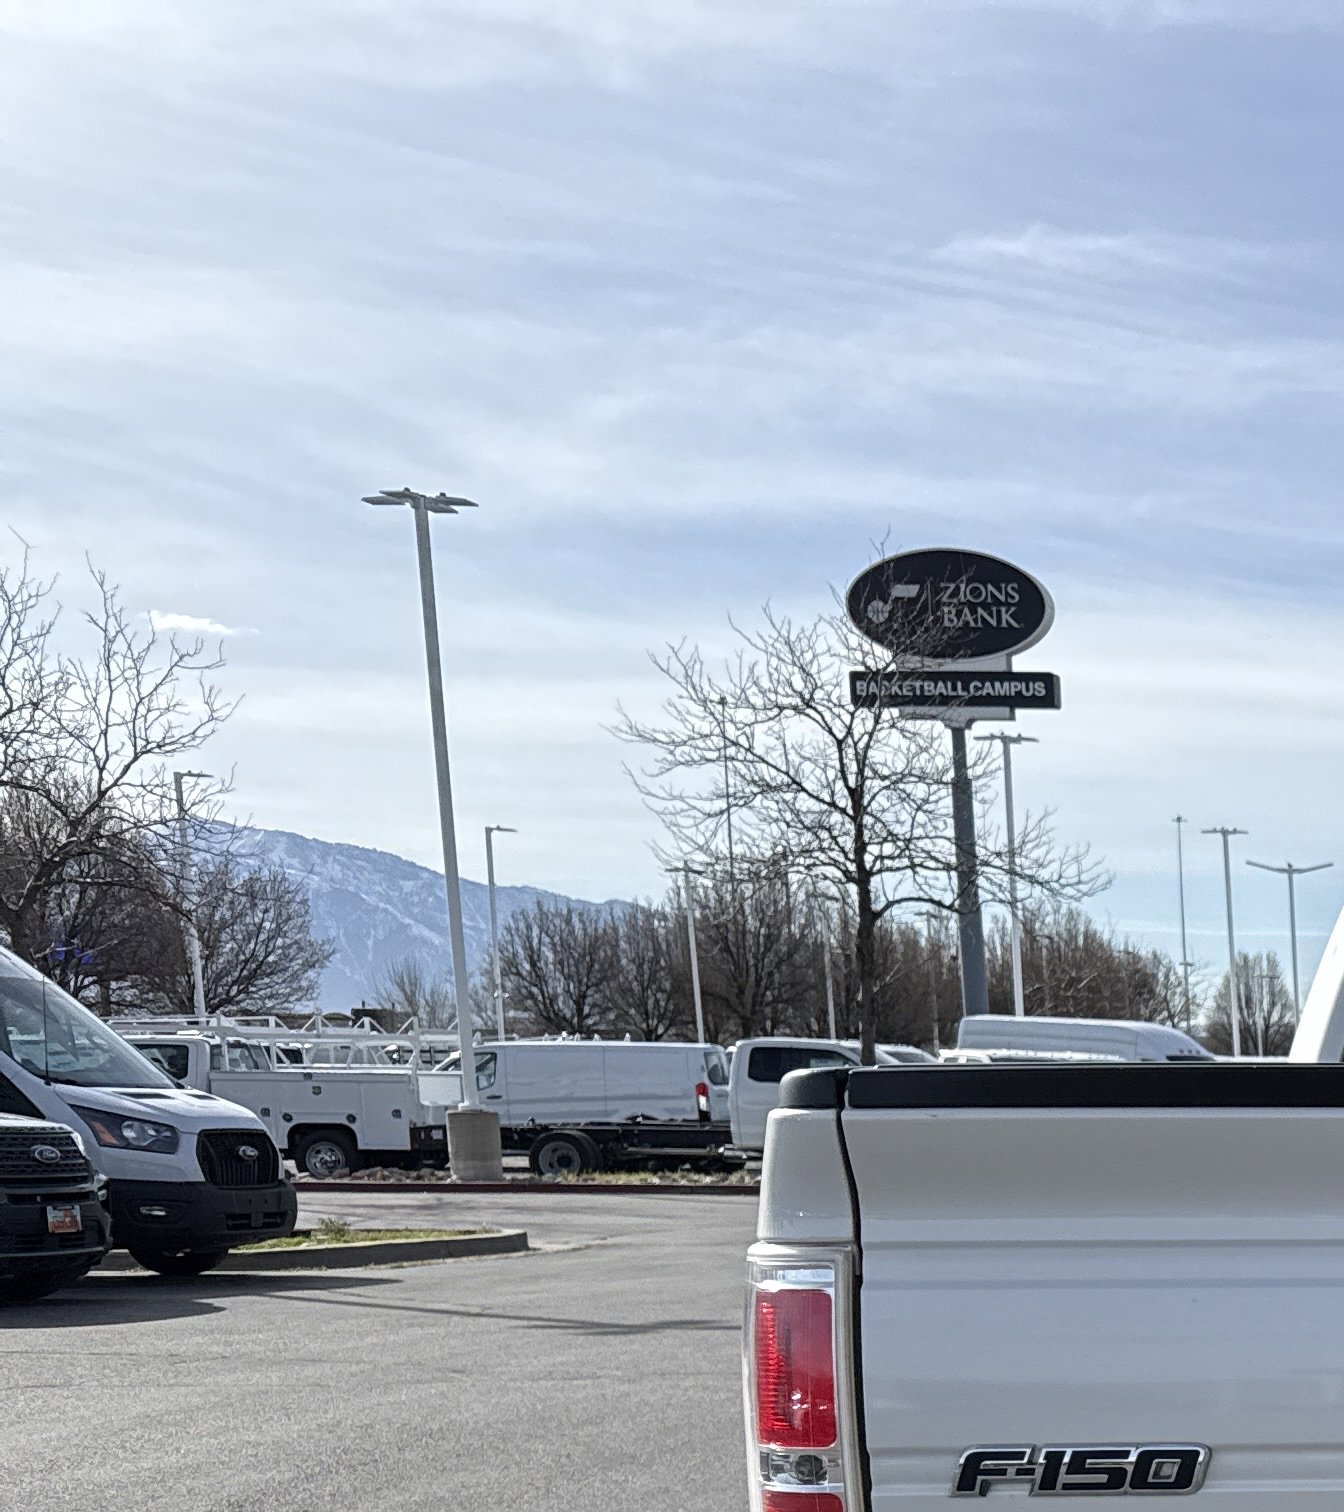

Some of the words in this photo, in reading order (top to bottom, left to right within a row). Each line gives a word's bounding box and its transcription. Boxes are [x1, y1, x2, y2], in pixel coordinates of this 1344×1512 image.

[939, 582, 1020, 604] ZIONS
[941, 605, 1021, 629] BANK
[969, 680, 1046, 697] CAMPUS
[949, 1444, 1211, 1498] F-150
